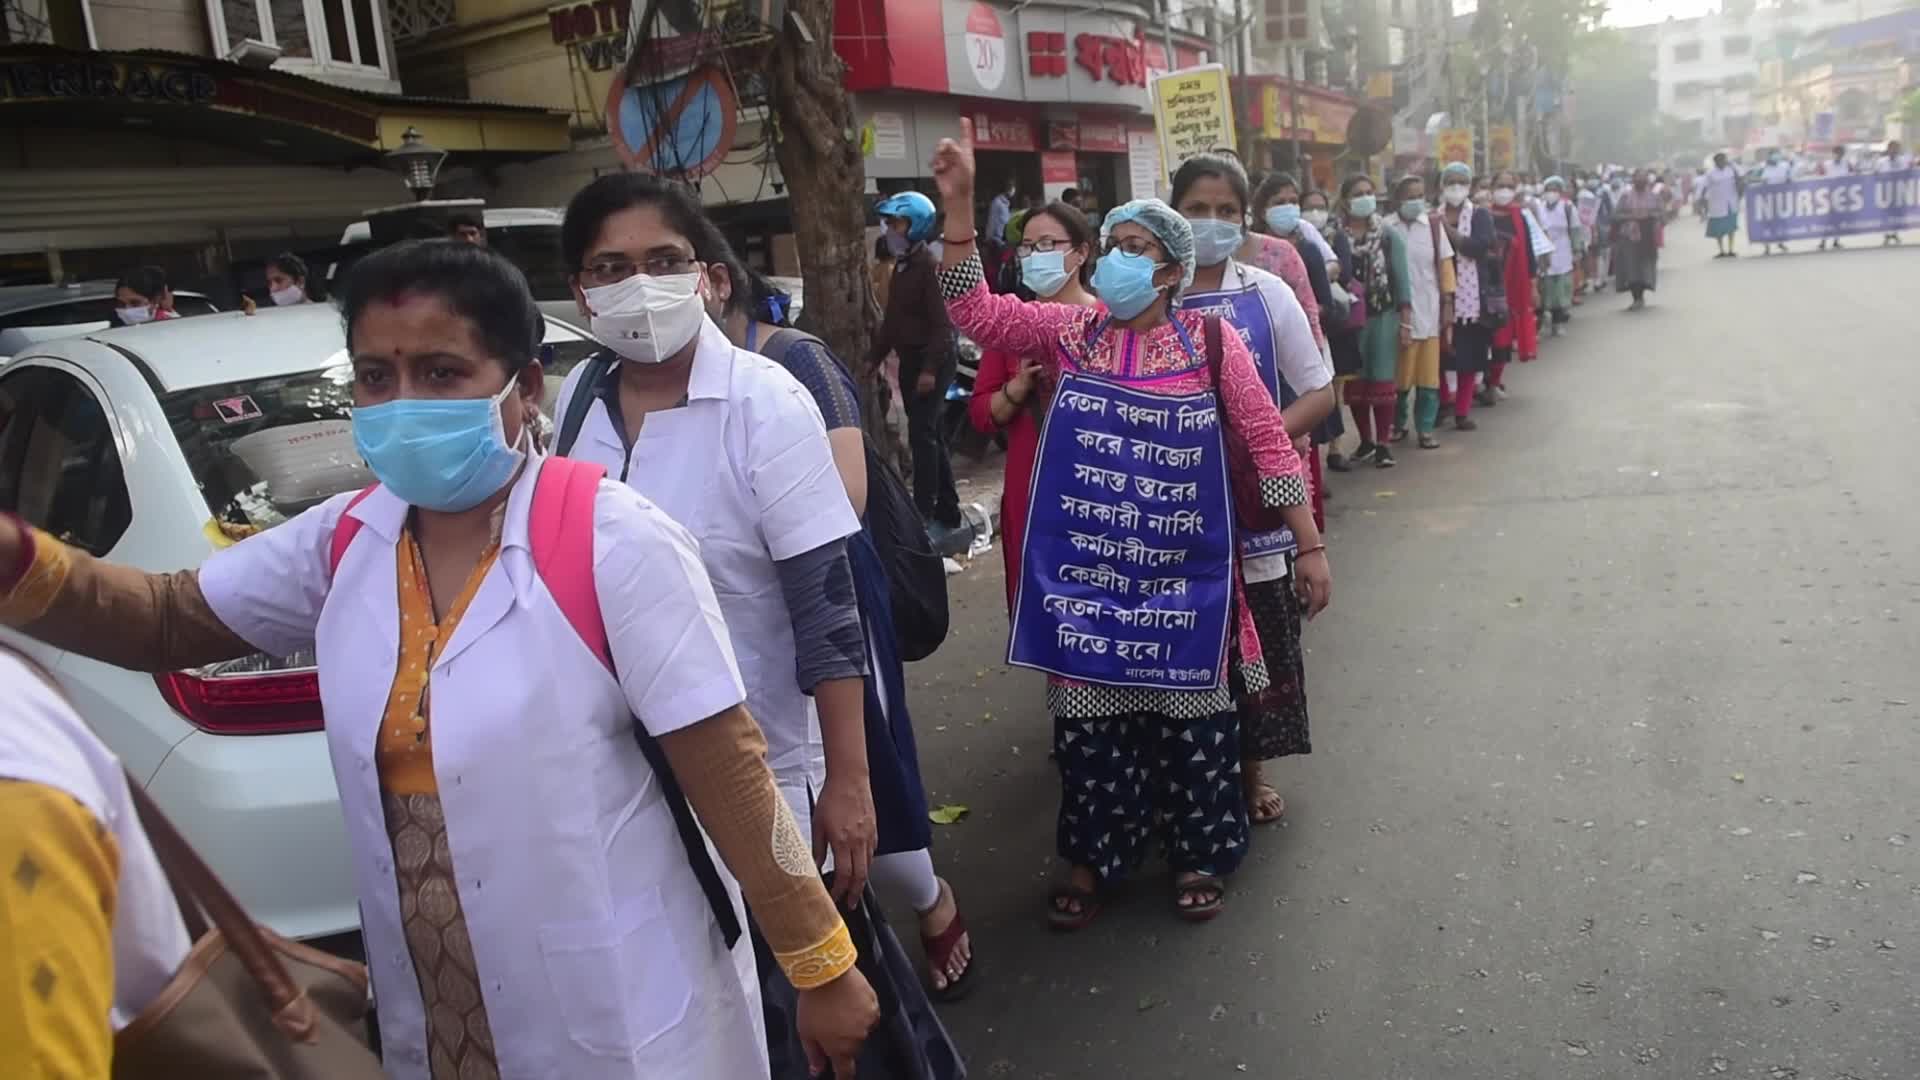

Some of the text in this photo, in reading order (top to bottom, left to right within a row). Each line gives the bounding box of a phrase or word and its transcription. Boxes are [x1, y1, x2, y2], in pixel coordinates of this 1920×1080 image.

[1755, 185, 1865, 221] NURSES
[1058, 390, 1108, 416] বেতন
[1114, 400, 1170, 431] বঞ্চনা
[1074, 428, 1203, 470] করে রাজ্যের
[1073, 463, 1197, 502] সমস্ত স্তরের
[1060, 494, 1204, 536] সরকারী নার্সিং
[1067, 530, 1188, 567] কর্মচারীদের
[1058, 563, 1187, 597] কেন্দ্রীয় হারে
[1043, 594, 1198, 630] বেতন-কাঠামো
[1056, 623, 1111, 654] দিতে
[1168, 668, 1212, 682] ইউনিটি
